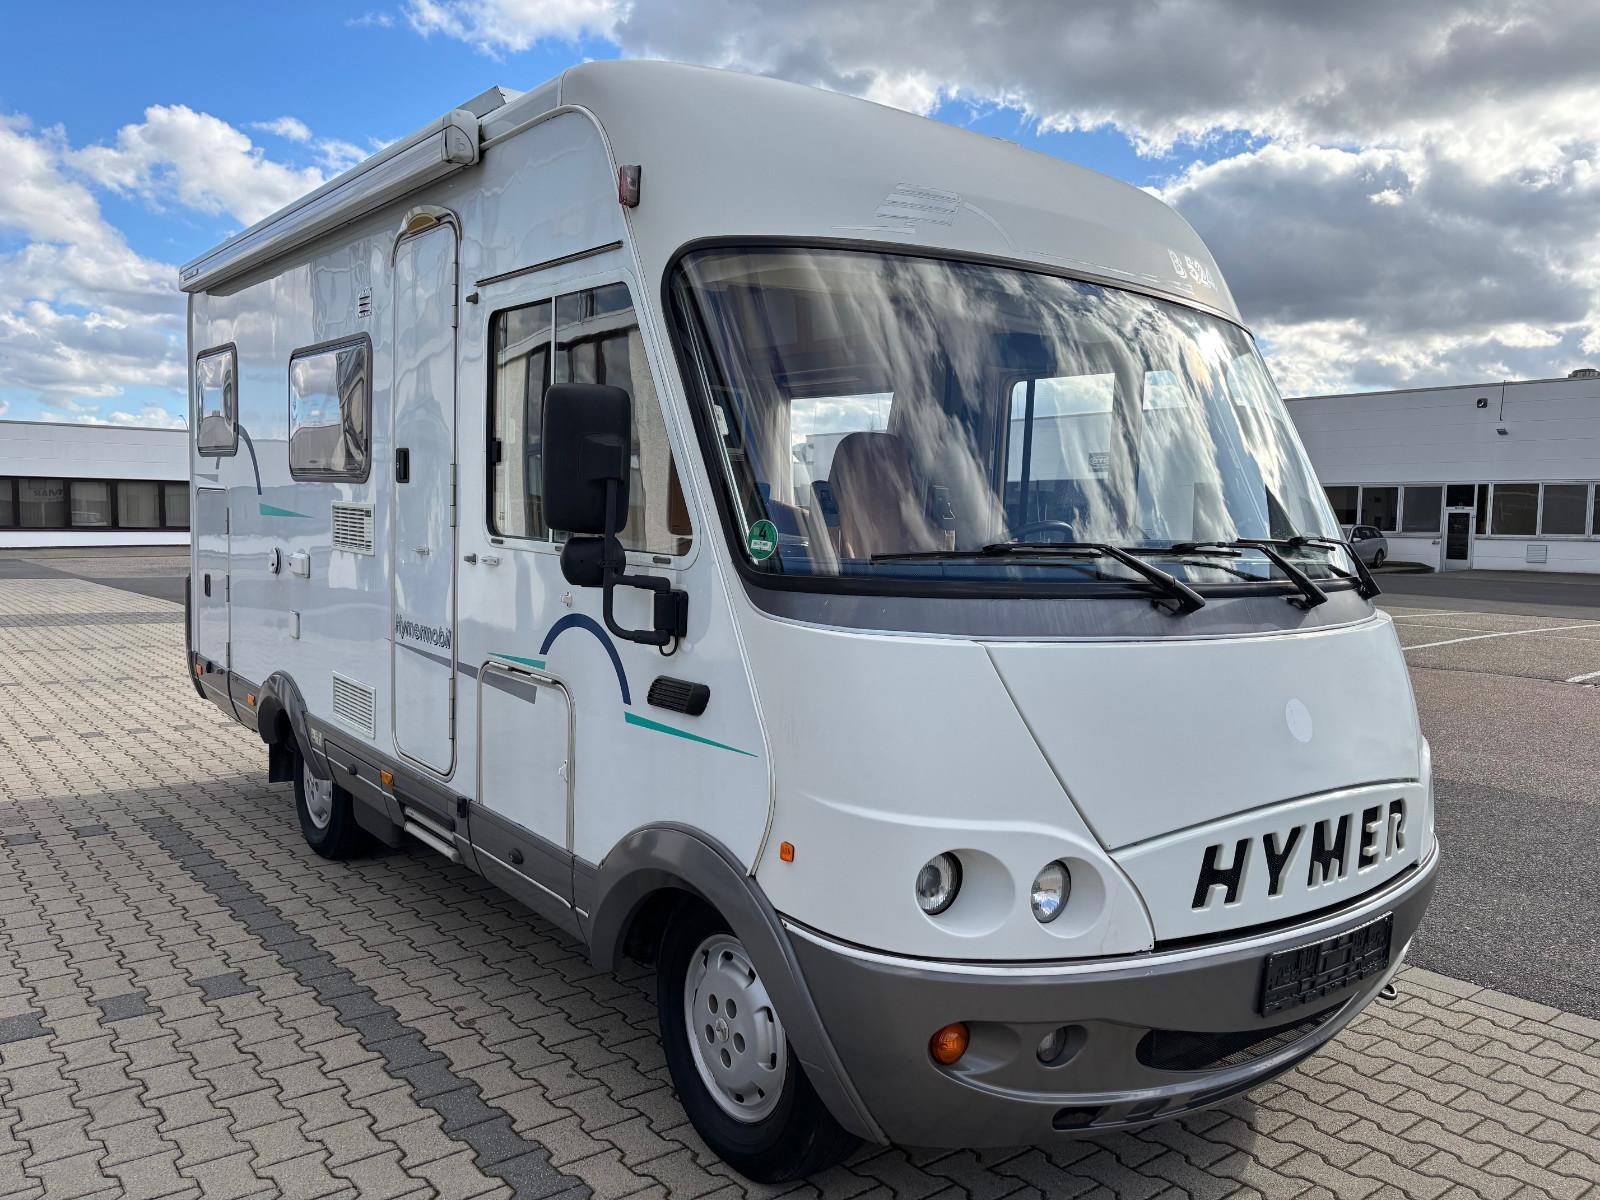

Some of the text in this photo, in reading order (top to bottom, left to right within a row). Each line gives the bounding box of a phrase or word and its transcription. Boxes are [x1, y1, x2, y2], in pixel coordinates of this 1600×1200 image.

[758, 522, 768, 541] 4
[395, 613, 452, 649] Hymermobil
[1190, 797, 1407, 912] HYMER
